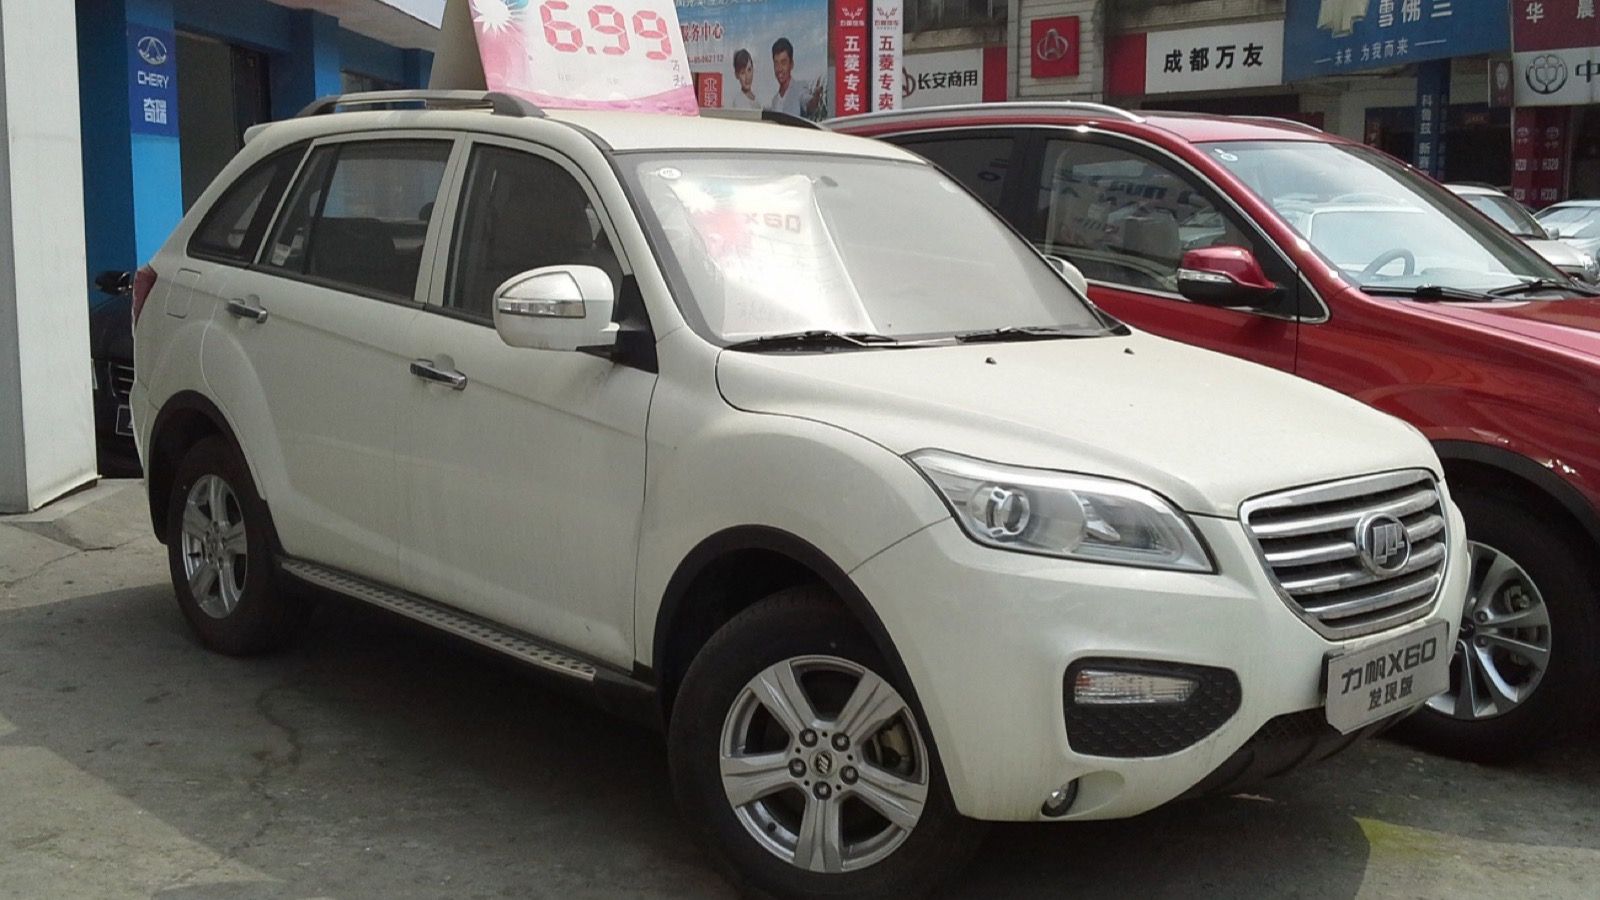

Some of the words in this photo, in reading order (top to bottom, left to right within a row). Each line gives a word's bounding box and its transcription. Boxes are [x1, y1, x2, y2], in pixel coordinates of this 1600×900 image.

[539, 0, 672, 60] 6.99
[878, 35, 894, 110] 五菱专卖
[1163, 43, 1264, 73] 成都万友
[138, 70, 169, 89] CHERY
[843, 35, 860, 112] 五菱专卖
[917, 69, 978, 90] 长安商用
[143, 97, 167, 125] 奇瑞
